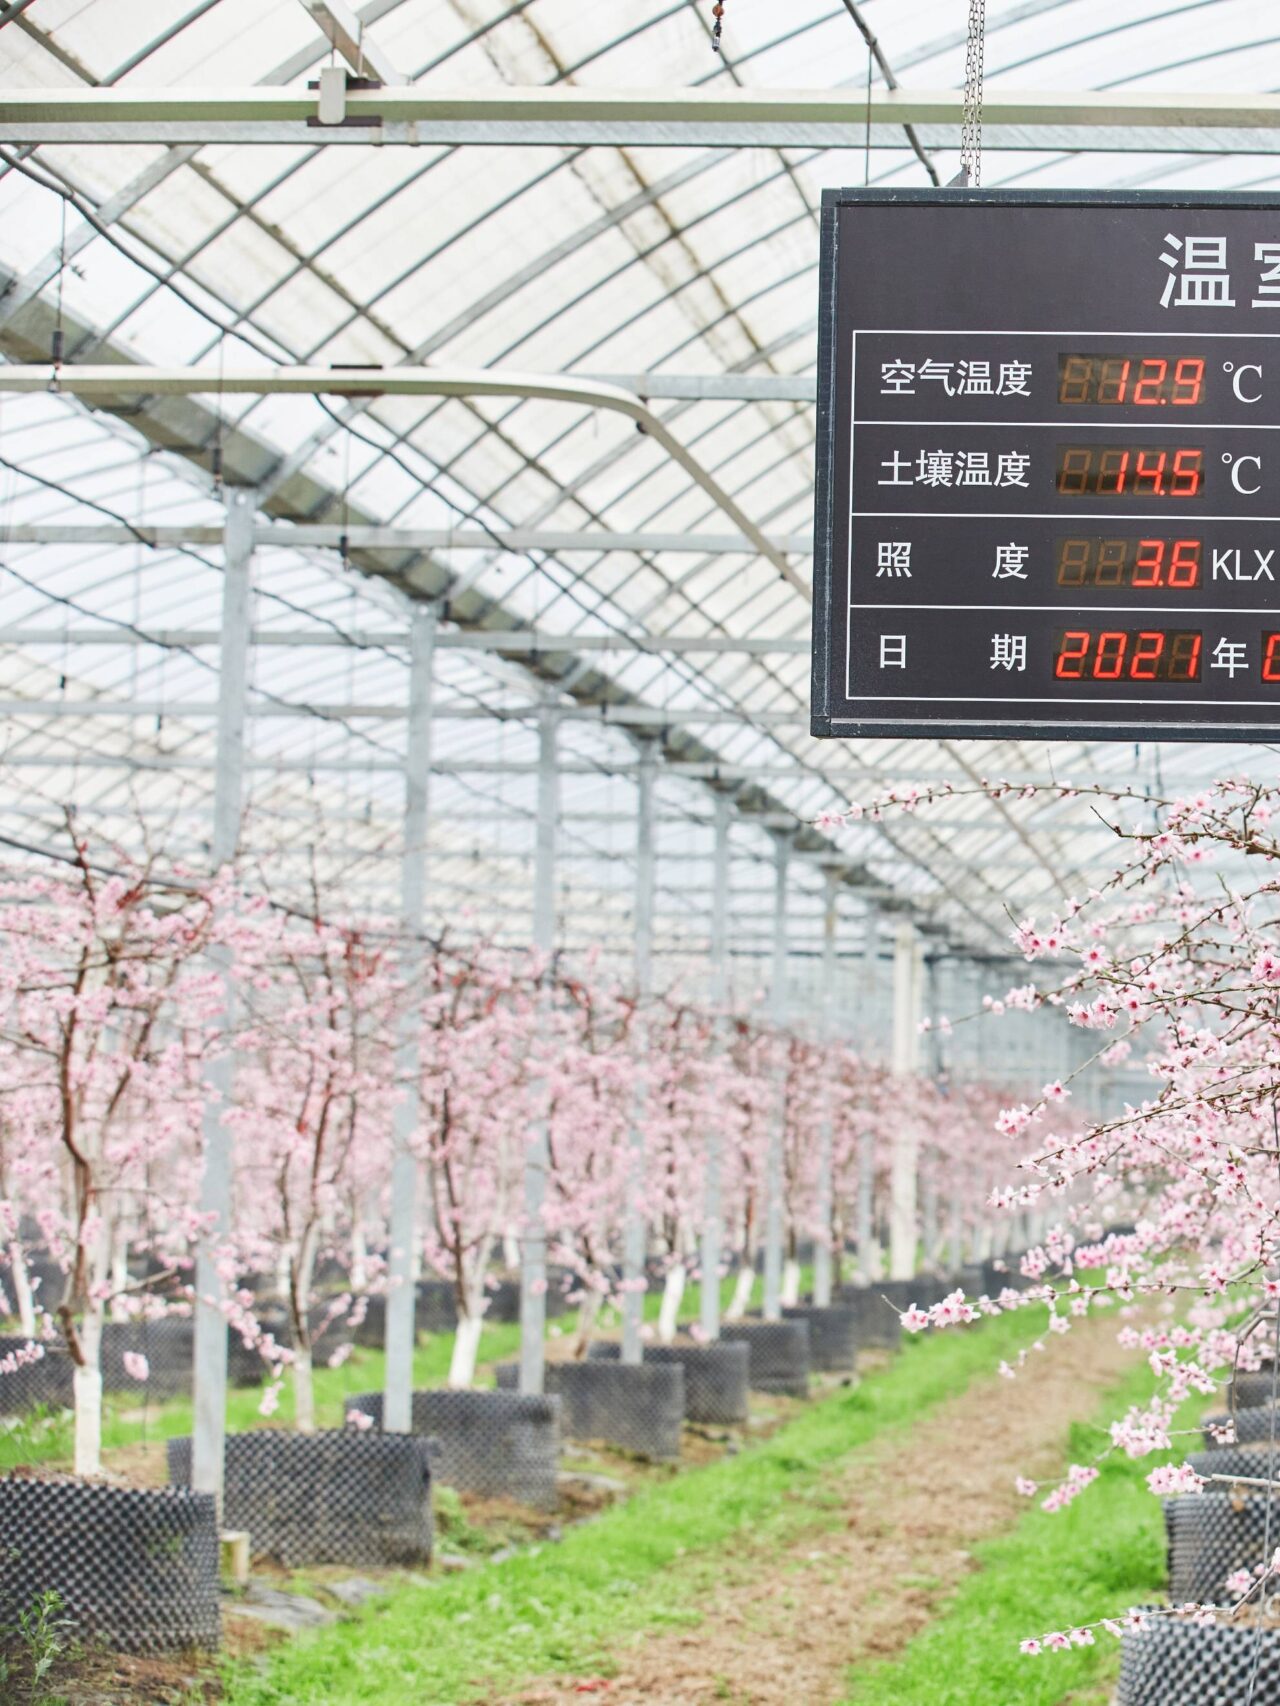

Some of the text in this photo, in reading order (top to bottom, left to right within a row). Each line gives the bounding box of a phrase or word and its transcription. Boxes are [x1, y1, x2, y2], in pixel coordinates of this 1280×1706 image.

[880, 358, 1034, 397] 空气温度
[1116, 358, 1205, 405] 12.9
[877, 449, 1031, 488] 土壤温度
[1116, 450, 1201, 496] 14.5
[1132, 540, 1200, 587] 3.6
[1212, 548, 1275, 581] KLX
[1055, 632, 1201, 680] 2021
